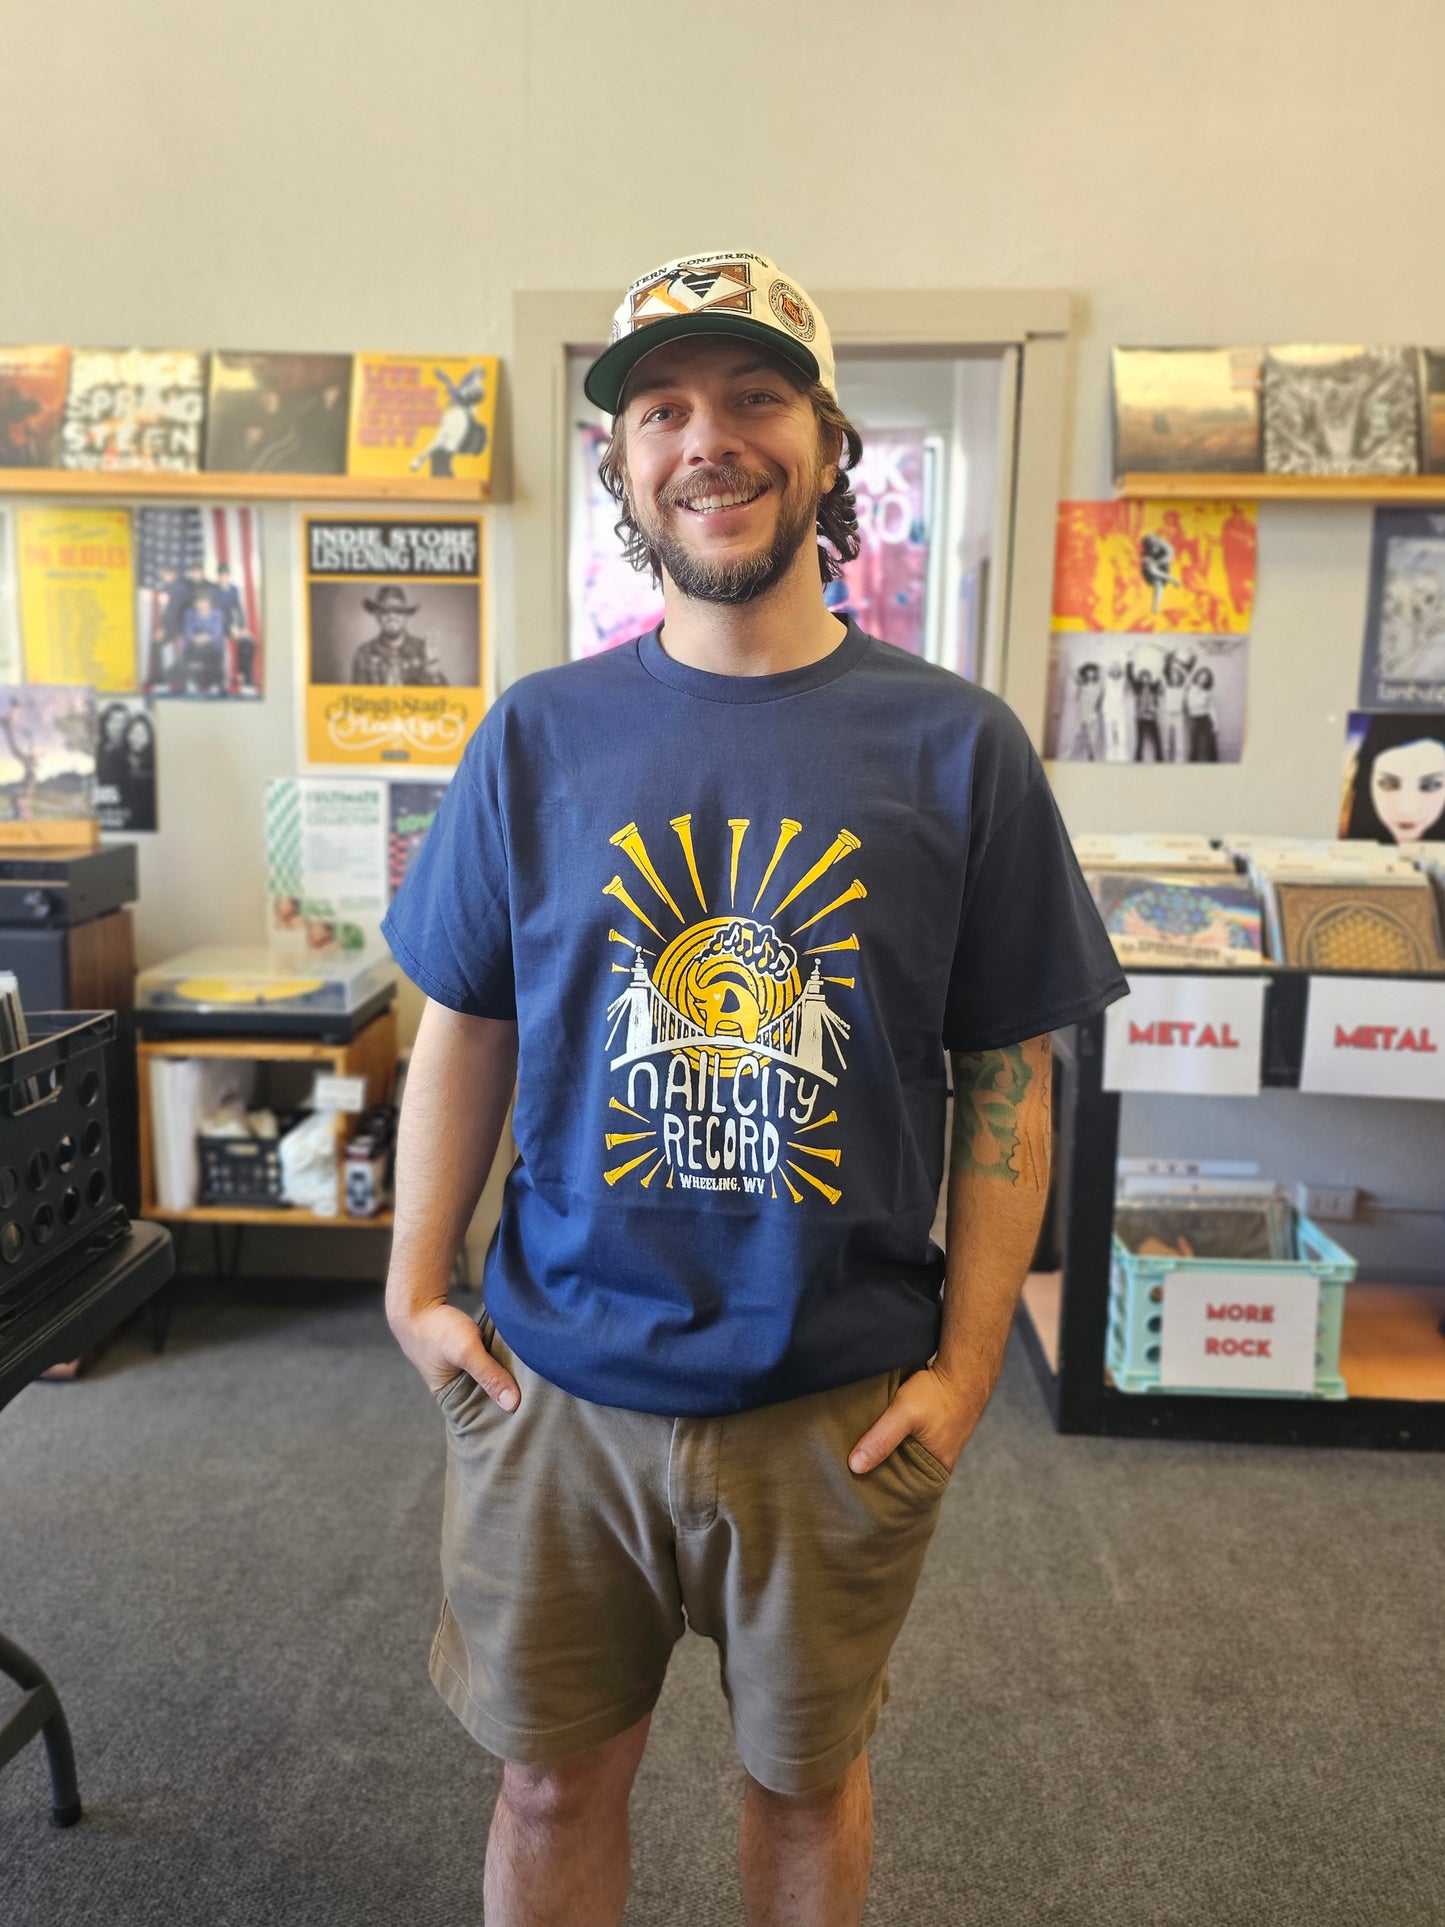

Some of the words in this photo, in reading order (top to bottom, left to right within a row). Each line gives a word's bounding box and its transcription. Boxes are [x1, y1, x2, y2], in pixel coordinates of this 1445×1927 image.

[311, 527, 383, 548] INDIE
[390, 528, 475, 550] STORE
[312, 546, 409, 571] LISTENING
[413, 549, 475, 571] PARTY
[1128, 1020, 1240, 1050] METAL
[1333, 1024, 1438, 1053] METAL
[663, 1112, 780, 1174] RECORD
[742, 1176, 766, 1195] WV
[1205, 1302, 1275, 1324] MORE
[1204, 1337, 1272, 1358] ROCK
